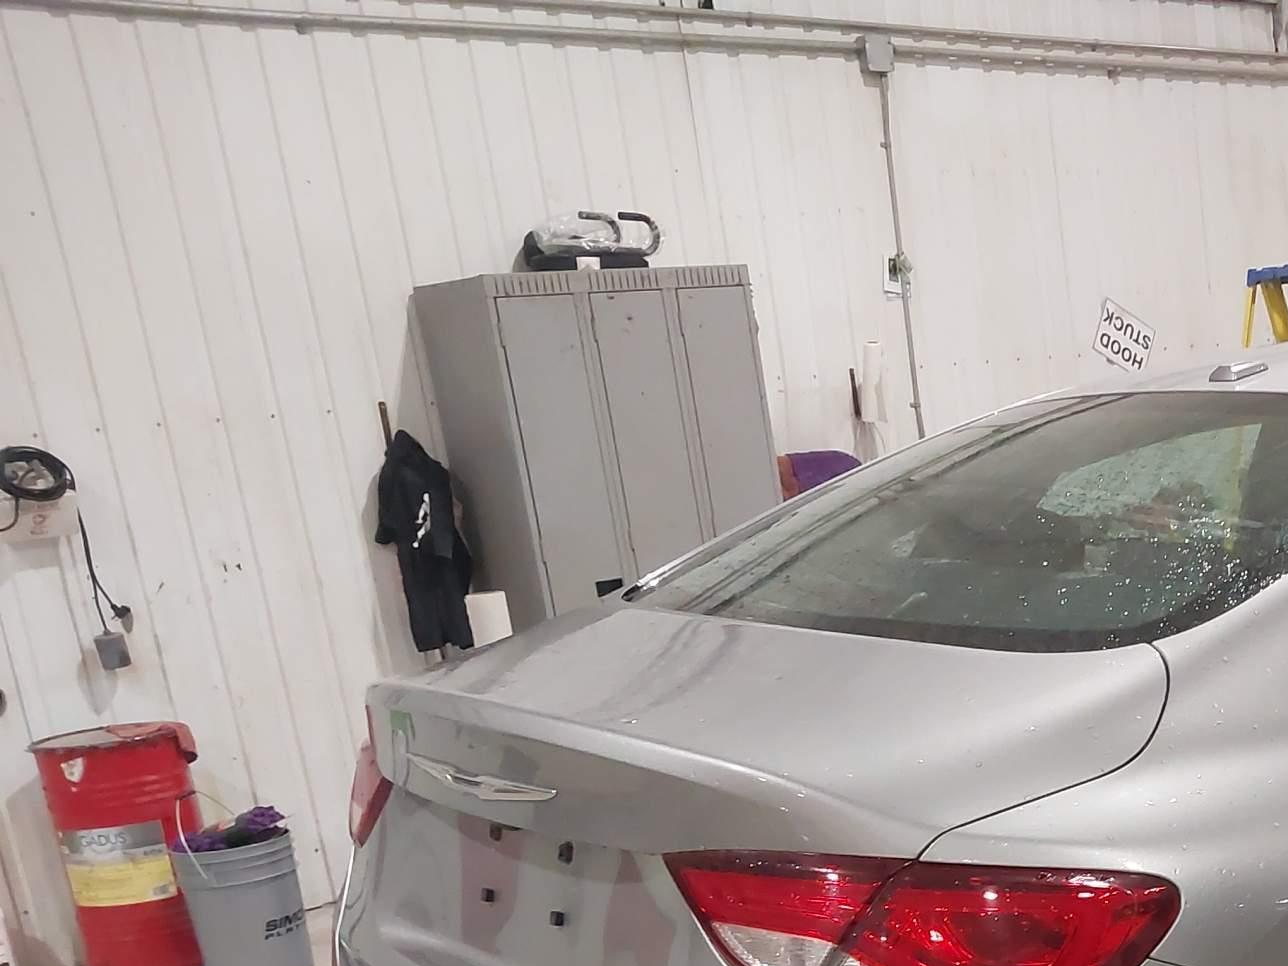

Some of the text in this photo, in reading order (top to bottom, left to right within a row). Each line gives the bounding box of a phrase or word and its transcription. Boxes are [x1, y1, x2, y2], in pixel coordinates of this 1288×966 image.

[1103, 307, 1151, 350] STUCK
[1100, 332, 1144, 370] HOOD
[80, 832, 129, 847] GADUS
